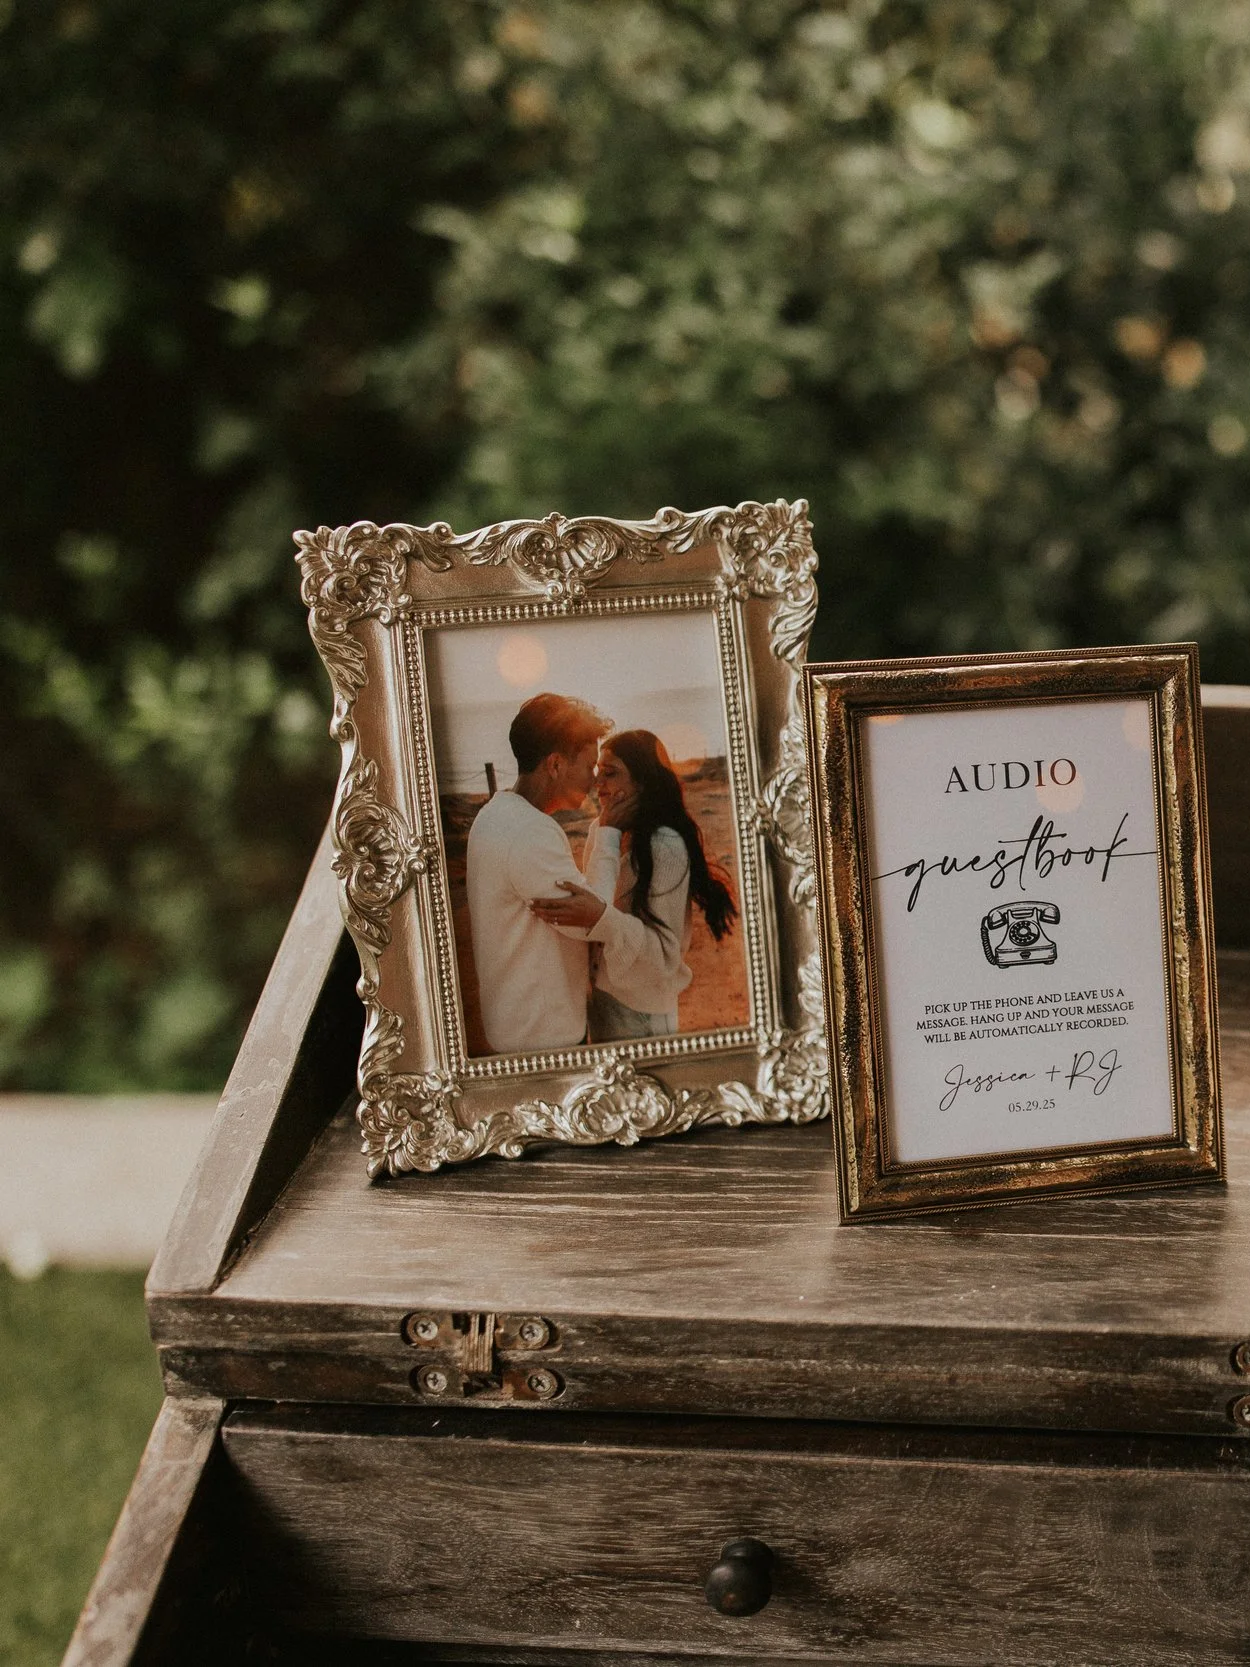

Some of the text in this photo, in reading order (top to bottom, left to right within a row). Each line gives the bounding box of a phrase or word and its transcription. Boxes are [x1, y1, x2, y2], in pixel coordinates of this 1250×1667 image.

[944, 758, 1077, 794] AUDIO
[872, 812, 1158, 912] guestbook
[924, 988, 1125, 1015] PICK UP THE PHONE AND LEAVE US A
[970, 1013, 1005, 1025] HANG
[1007, 1012, 1022, 1022] UP
[1024, 1009, 1050, 1020] AND
[1052, 1006, 1084, 1017] YOUR
[1086, 1001, 1135, 1014] MESSAGE
[924, 1016, 1129, 1044] WILL BE AUTOMATICALLY RECORDED.
[939, 1049, 1123, 1111] Jessica + RJ
[1008, 1098, 1056, 1113] 05.29.25
